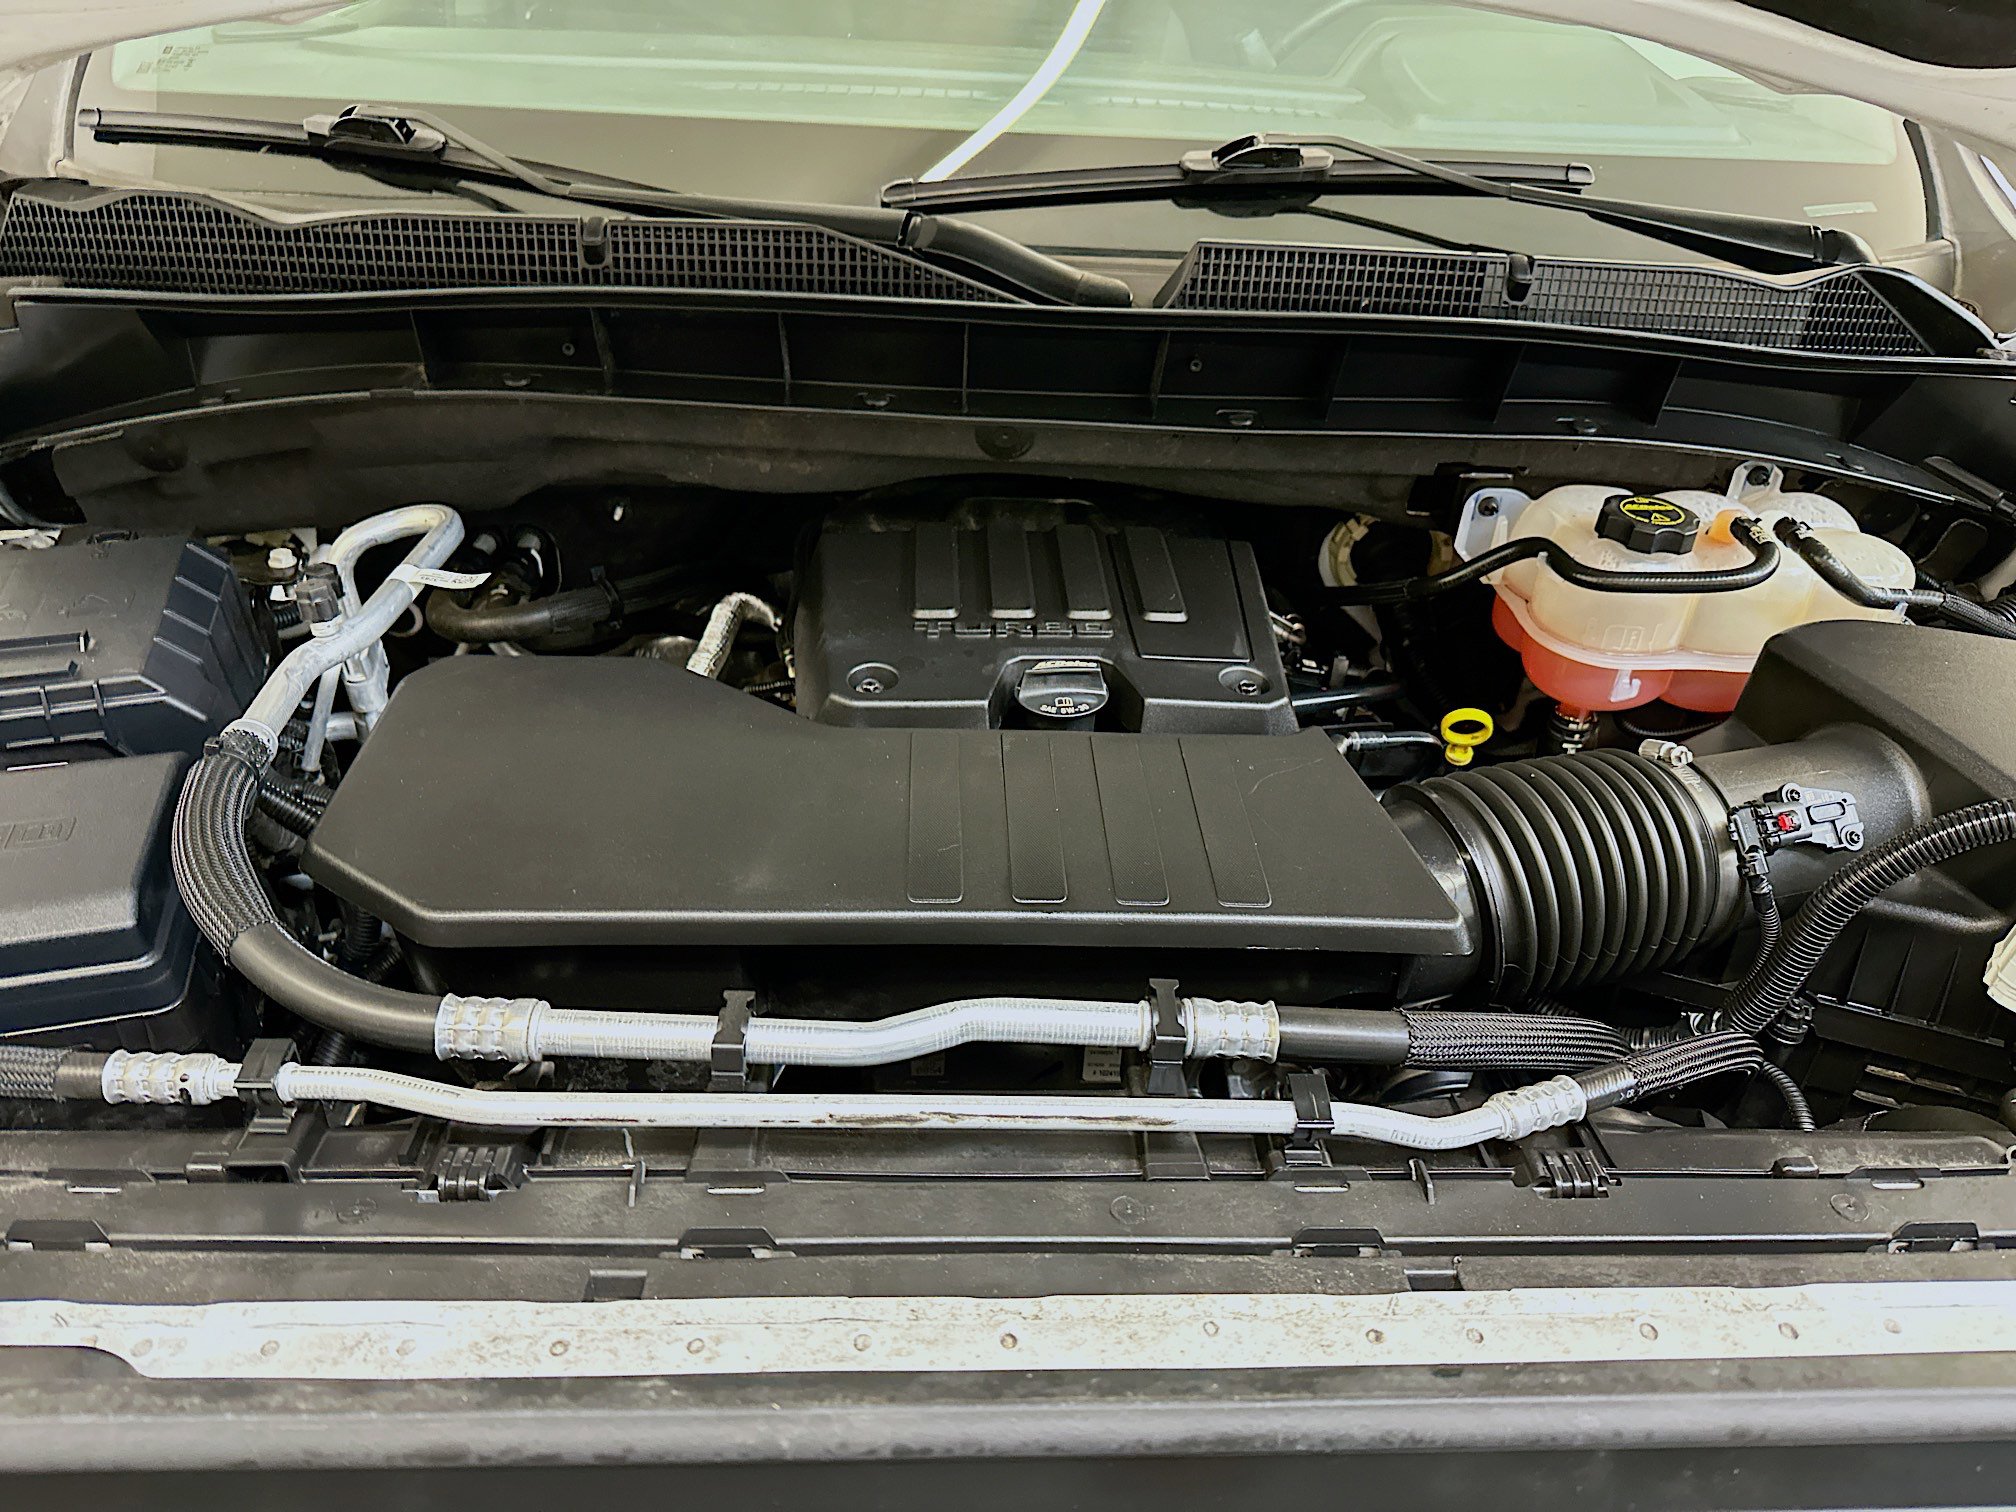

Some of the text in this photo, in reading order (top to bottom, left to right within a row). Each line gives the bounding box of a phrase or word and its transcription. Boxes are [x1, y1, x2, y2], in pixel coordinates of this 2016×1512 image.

[913, 621, 1114, 638] TURBO
[1040, 703, 1090, 714] SAE 5W-30
